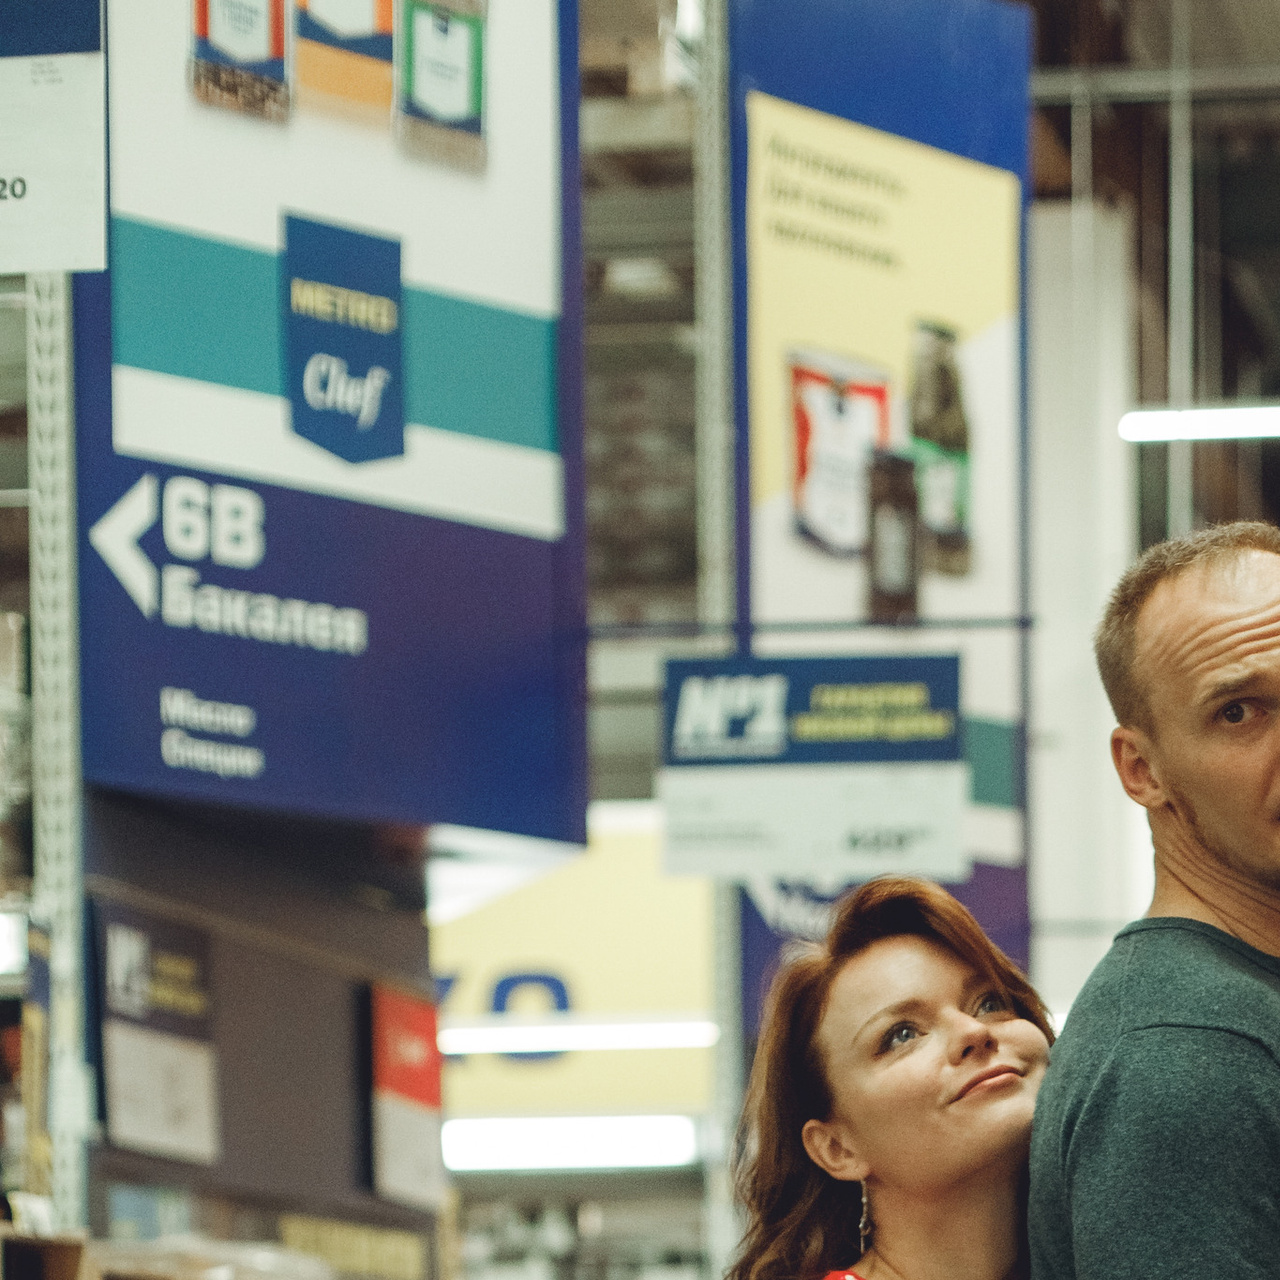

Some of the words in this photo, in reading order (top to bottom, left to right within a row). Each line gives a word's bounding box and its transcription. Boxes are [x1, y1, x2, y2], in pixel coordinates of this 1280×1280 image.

[291, 277, 397, 335] METRO
[303, 352, 392, 432] Chef
[161, 562, 369, 657] Бакалея
